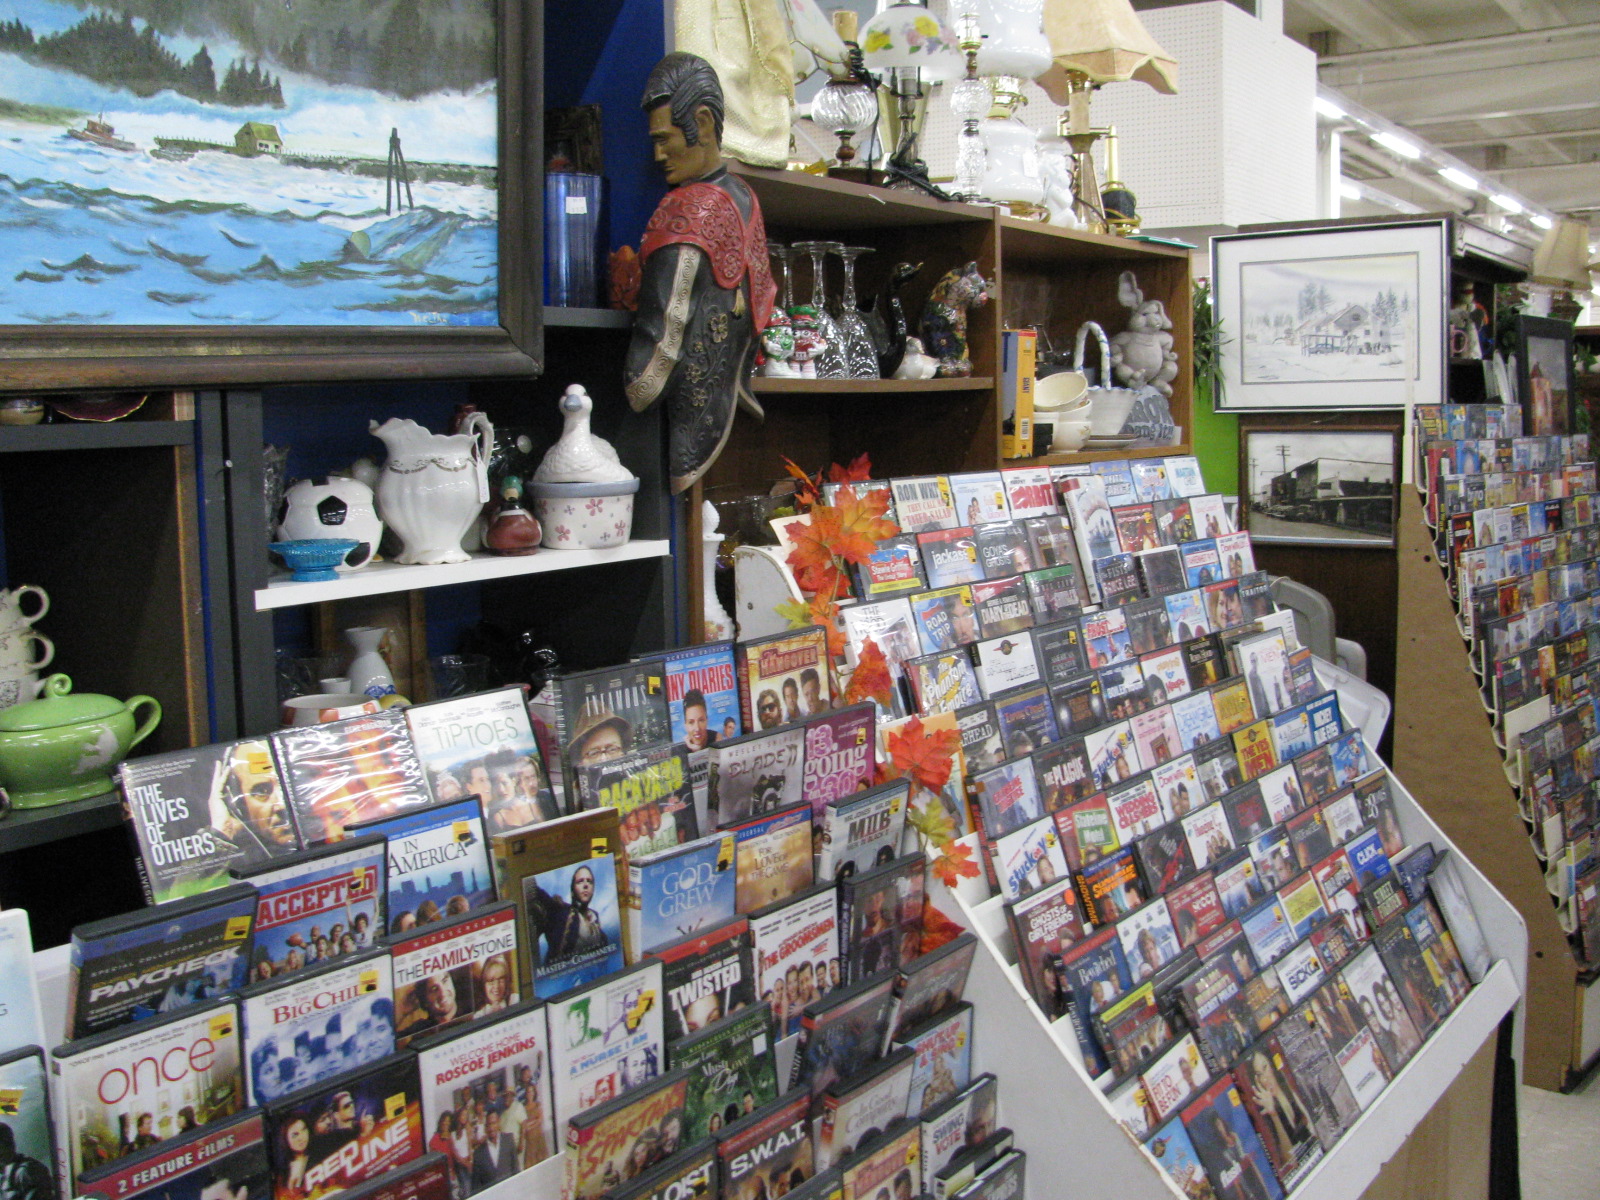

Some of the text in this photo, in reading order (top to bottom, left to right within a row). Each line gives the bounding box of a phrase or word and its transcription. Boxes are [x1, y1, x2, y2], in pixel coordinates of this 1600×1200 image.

[897, 483, 918, 500] RON
[925, 612, 949, 632] ROAD
[931, 624, 951, 642] TRIP
[586, 685, 648, 717] INFAMOUS
[961, 724, 994, 747] RHEAD
[134, 782, 165, 804] THE
[139, 797, 190, 828] LIVES
[145, 823, 167, 846] OF
[151, 832, 216, 867] OTHERS
[404, 838, 419, 854] IN
[388, 840, 469, 878] AMERICA
[662, 862, 713, 895] GOD
[256, 876, 378, 927] ACCEPTD
[658, 883, 715, 919] GREW
[413, 917, 497, 948] WIDESCREEN
[1028, 911, 1074, 943] GIRLFRIENDS
[1030, 907, 1059, 930] GHOSTS
[89, 946, 242, 1003] PAYCHECK
[536, 961, 563, 979] MASTER
[763, 950, 779, 972] THE
[668, 961, 742, 1013] TWISTED
[274, 1000, 319, 1025] BIG
[312, 983, 361, 1015] CHIL
[435, 1037, 536, 1086] ROSCOE JENKINS
[449, 1032, 522, 1068] WELCOME HOME
[581, 1045, 621, 1069] NURSE
[632, 1033, 648, 1046] AM
[98, 1037, 216, 1105] once
[118, 1133, 236, 1194] 2 FEATURE FILMS
[731, 1119, 806, 1178] S.W.A.T.
